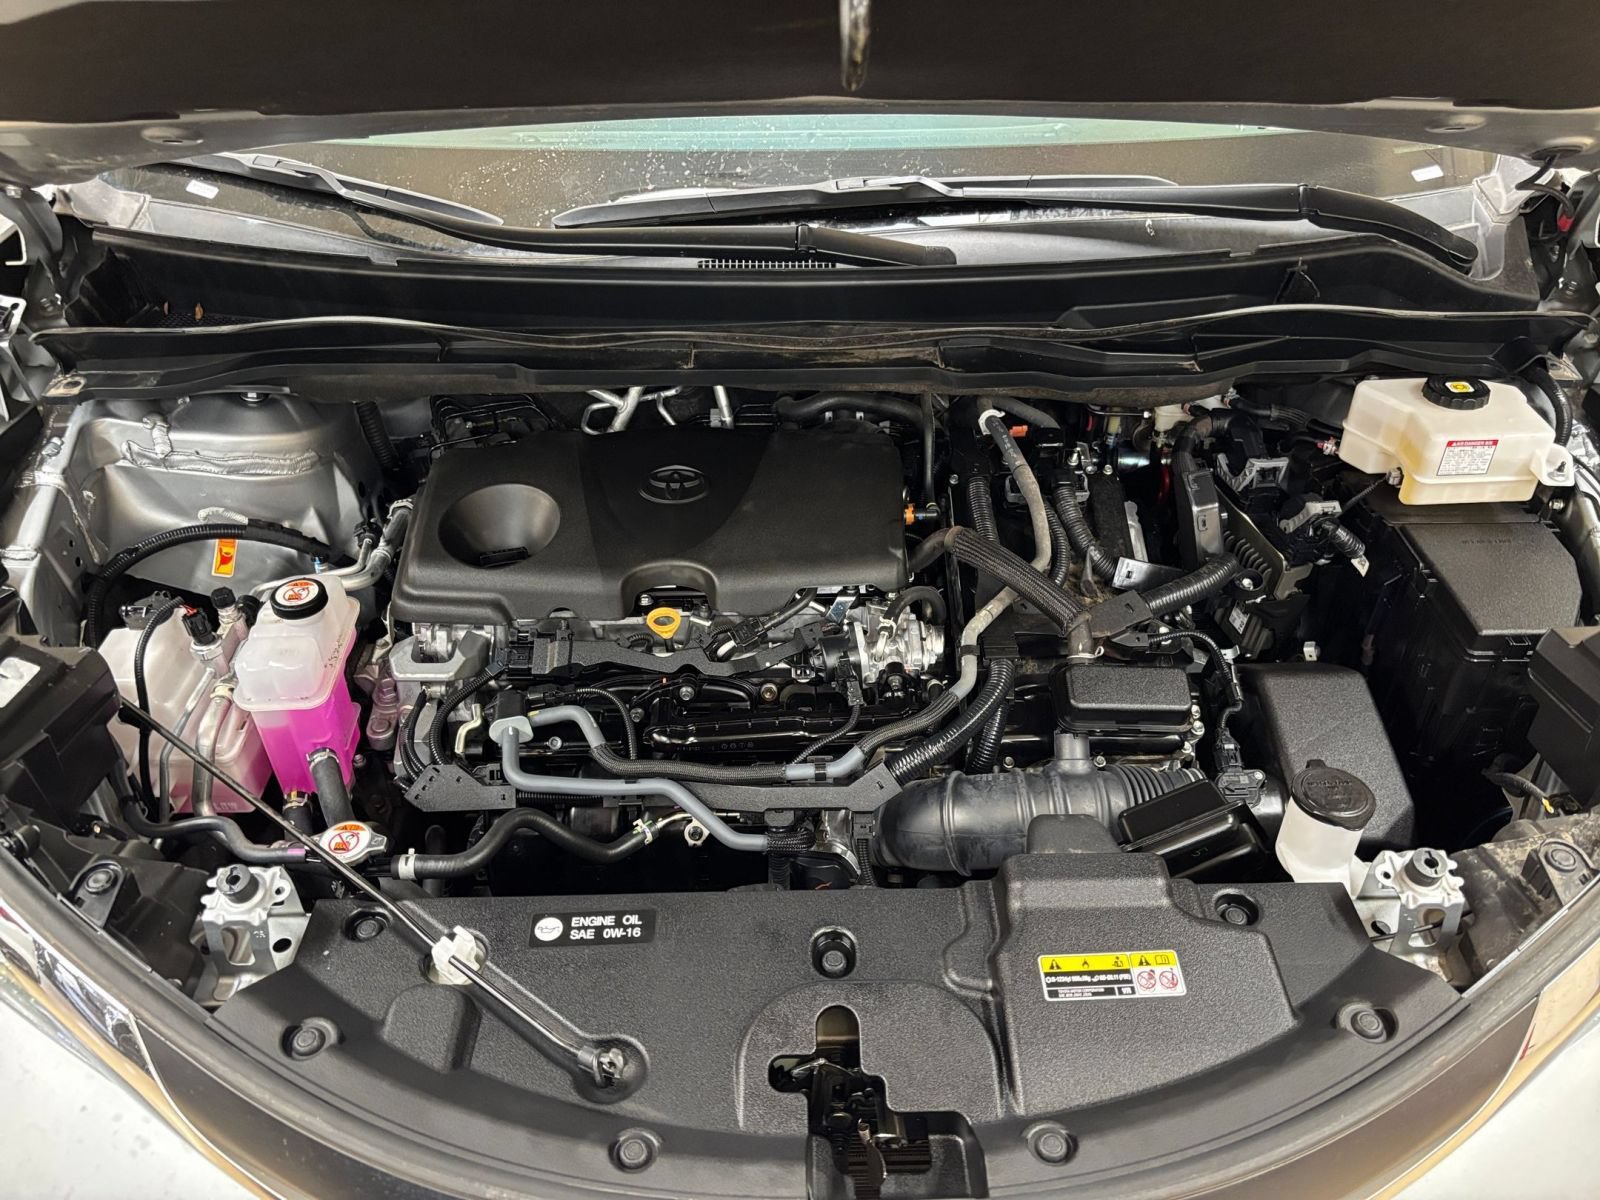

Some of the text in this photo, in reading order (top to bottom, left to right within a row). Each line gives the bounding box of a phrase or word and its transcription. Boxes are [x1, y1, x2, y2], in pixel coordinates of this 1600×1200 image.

[571, 914, 642, 927] ENGINE OIL
[569, 927, 641, 940] SAE 0W-16
